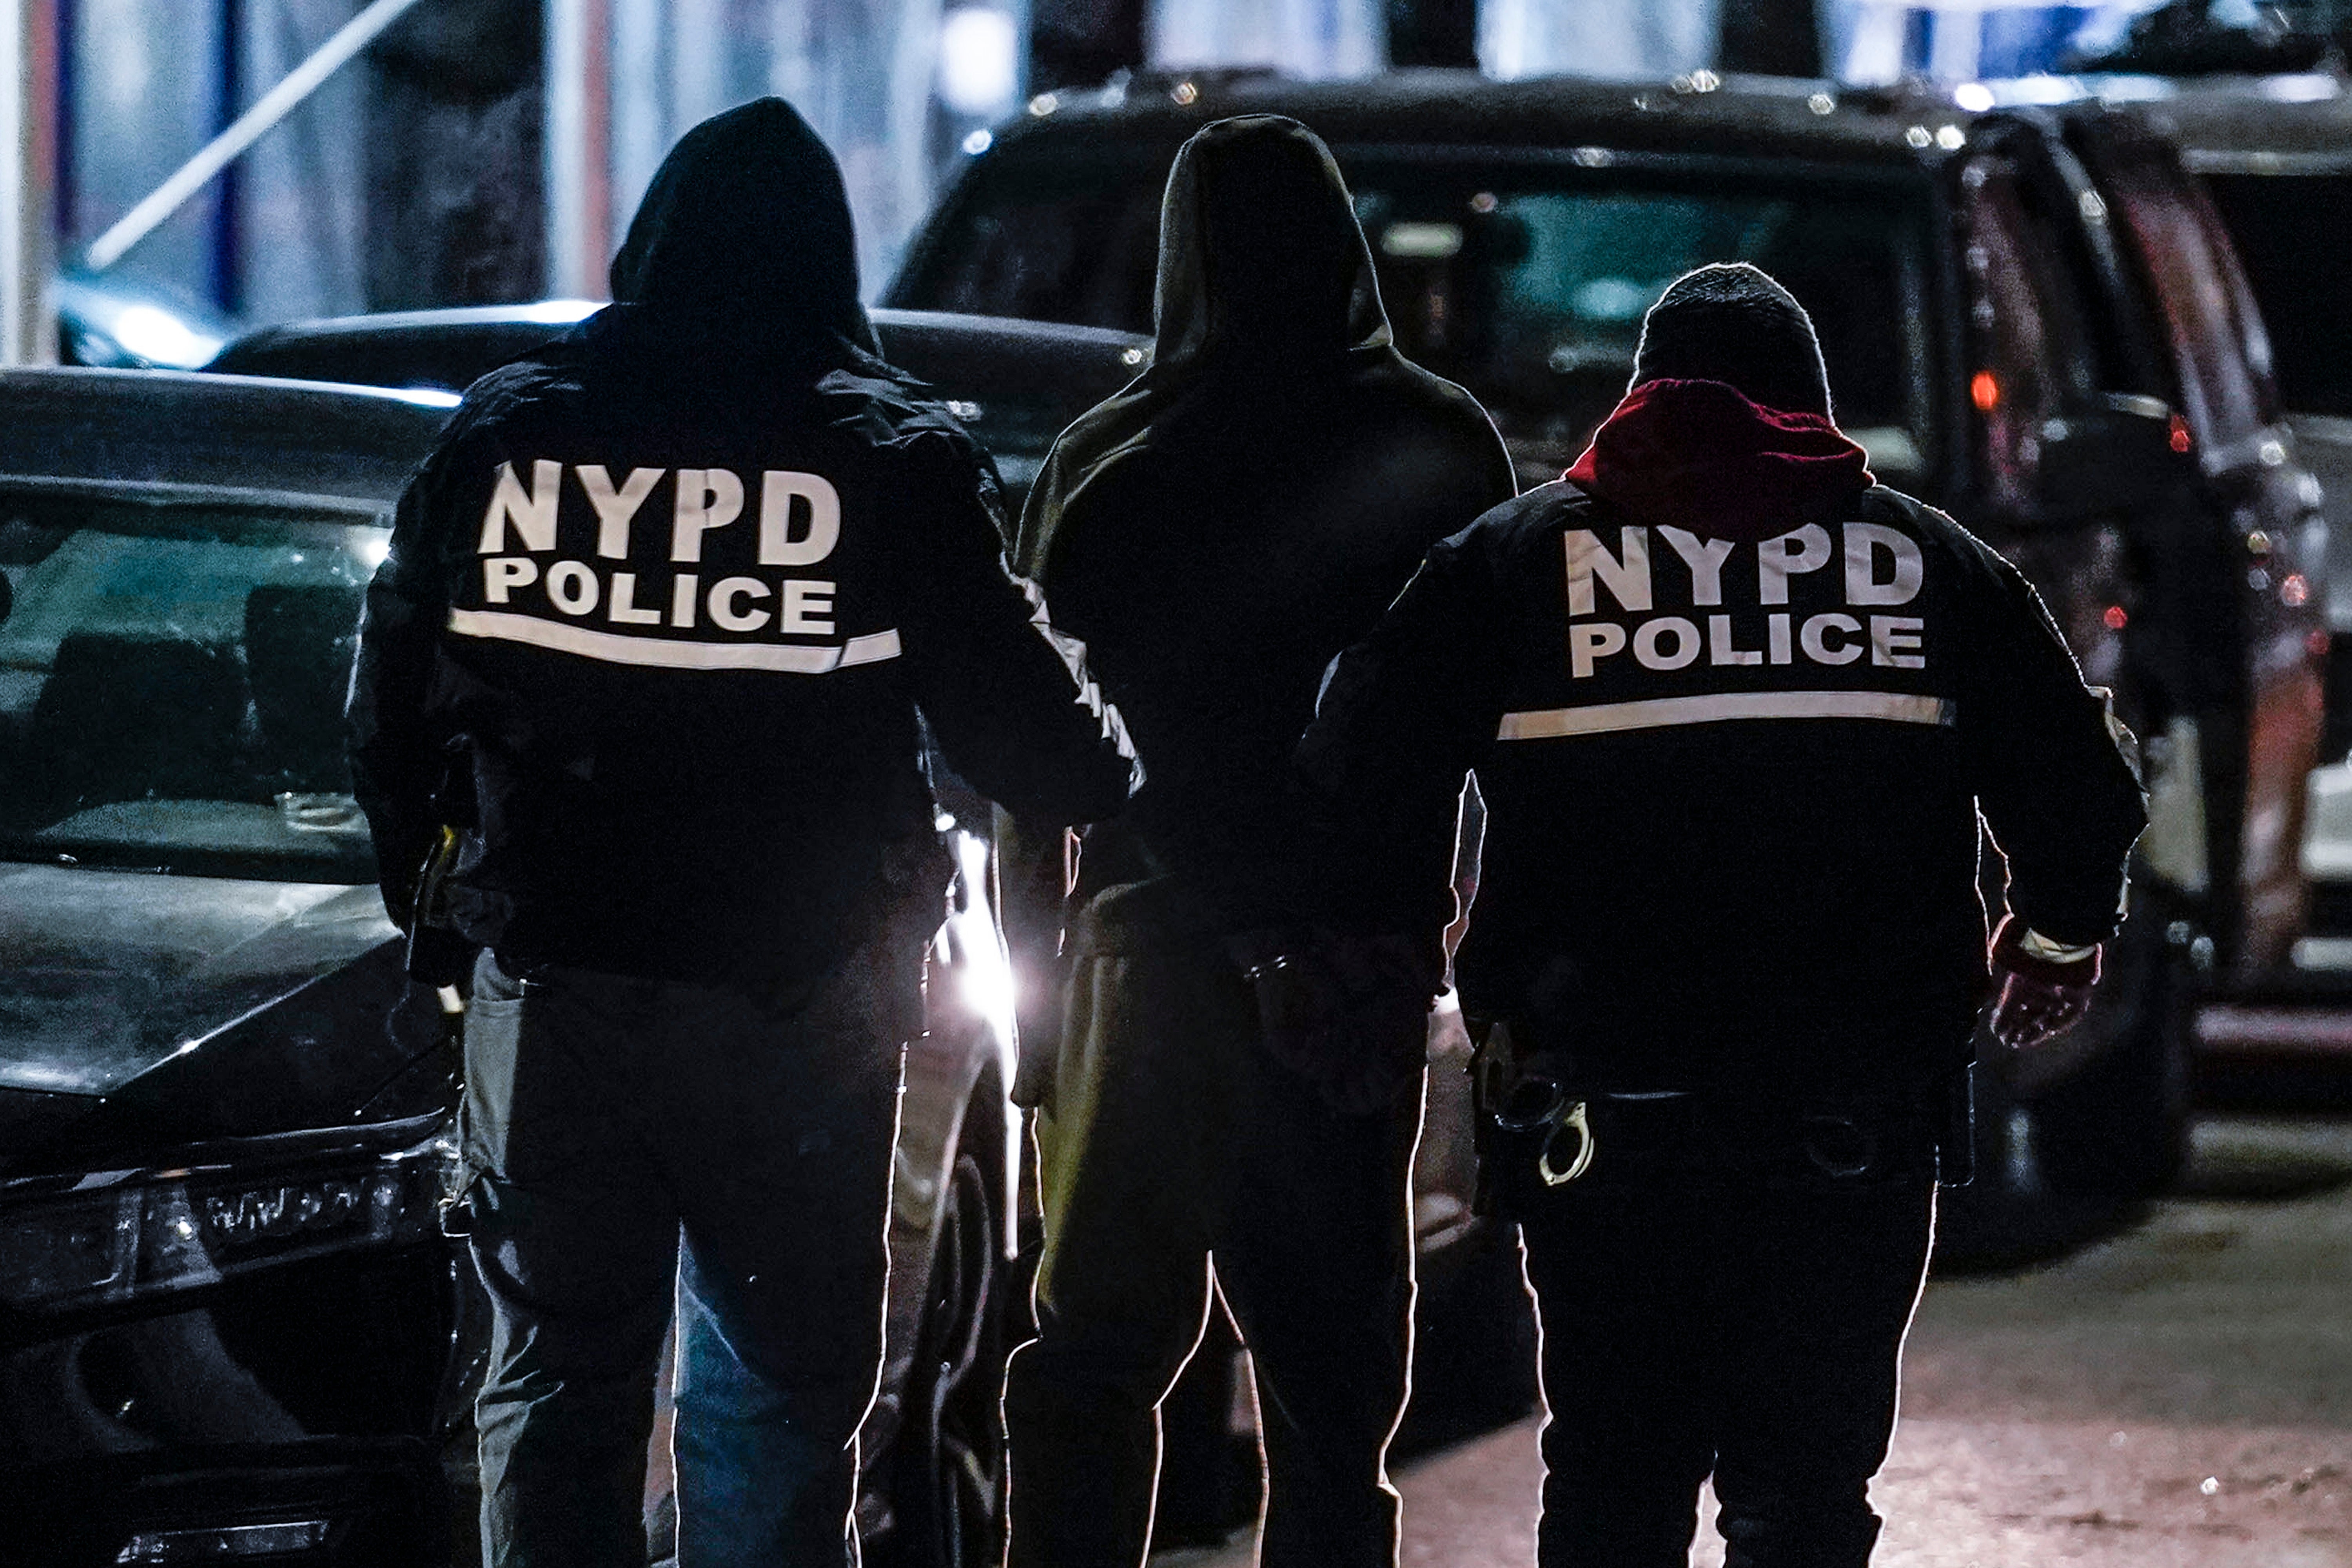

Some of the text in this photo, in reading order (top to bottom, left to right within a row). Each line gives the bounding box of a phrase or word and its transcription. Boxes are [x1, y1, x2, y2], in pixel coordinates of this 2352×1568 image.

[477, 459, 841, 566] NYPD
[484, 557, 837, 634] POLICE
[1564, 522, 1924, 617] NYPD
[1569, 613, 1926, 678] POLICE
